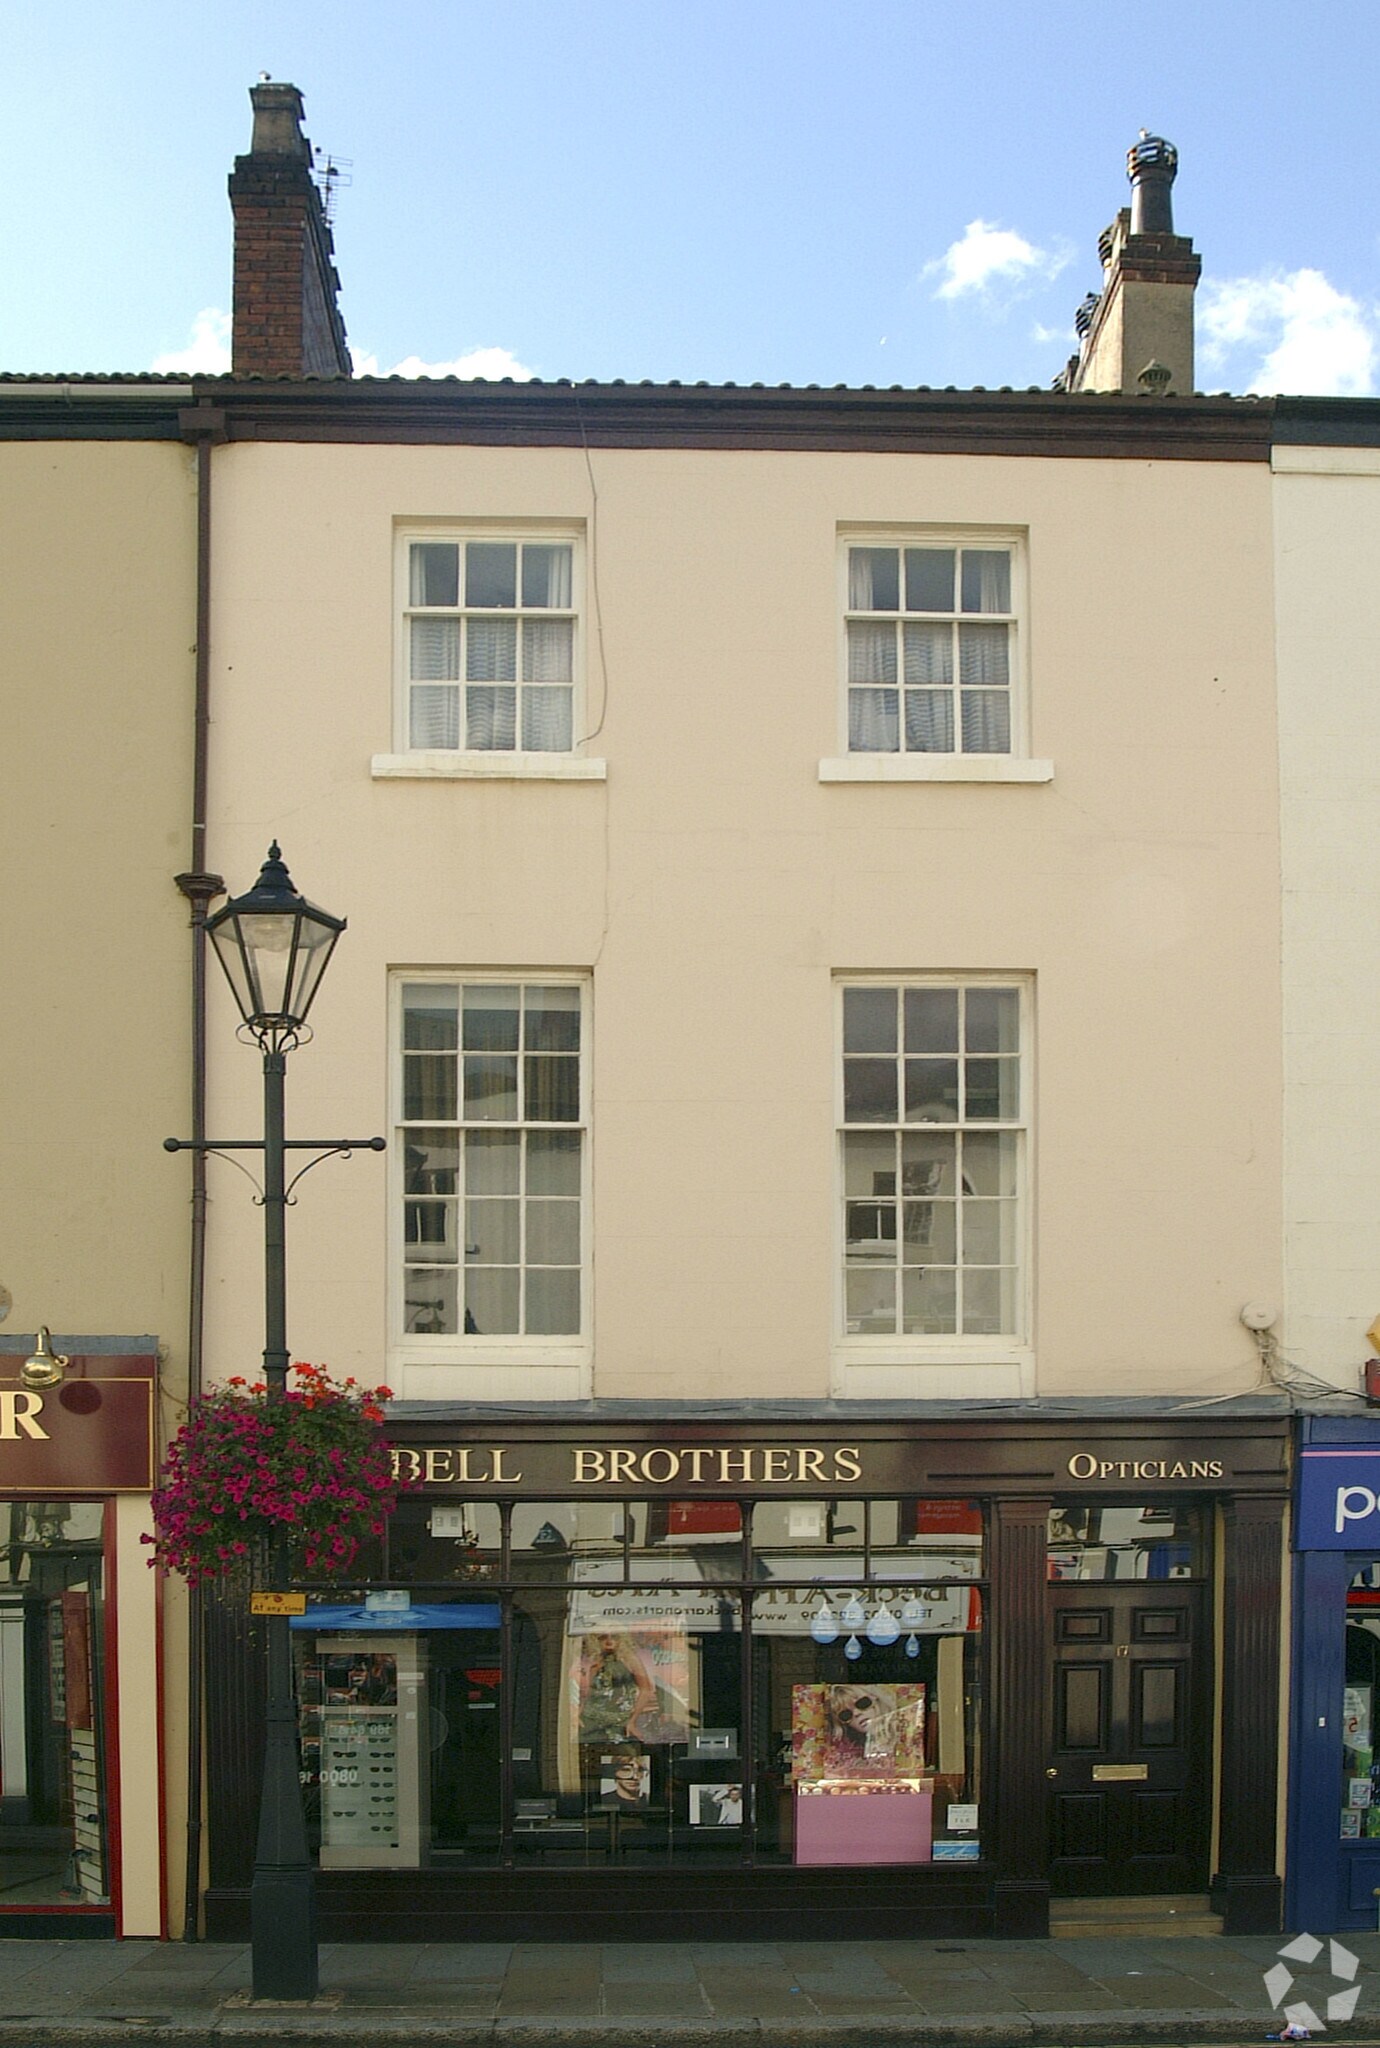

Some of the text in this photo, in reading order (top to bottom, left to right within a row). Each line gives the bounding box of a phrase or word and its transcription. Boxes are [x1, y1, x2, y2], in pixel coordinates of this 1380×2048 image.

[0, 1390, 51, 1440] R
[388, 1447, 862, 1483] BELL BROTHERS
